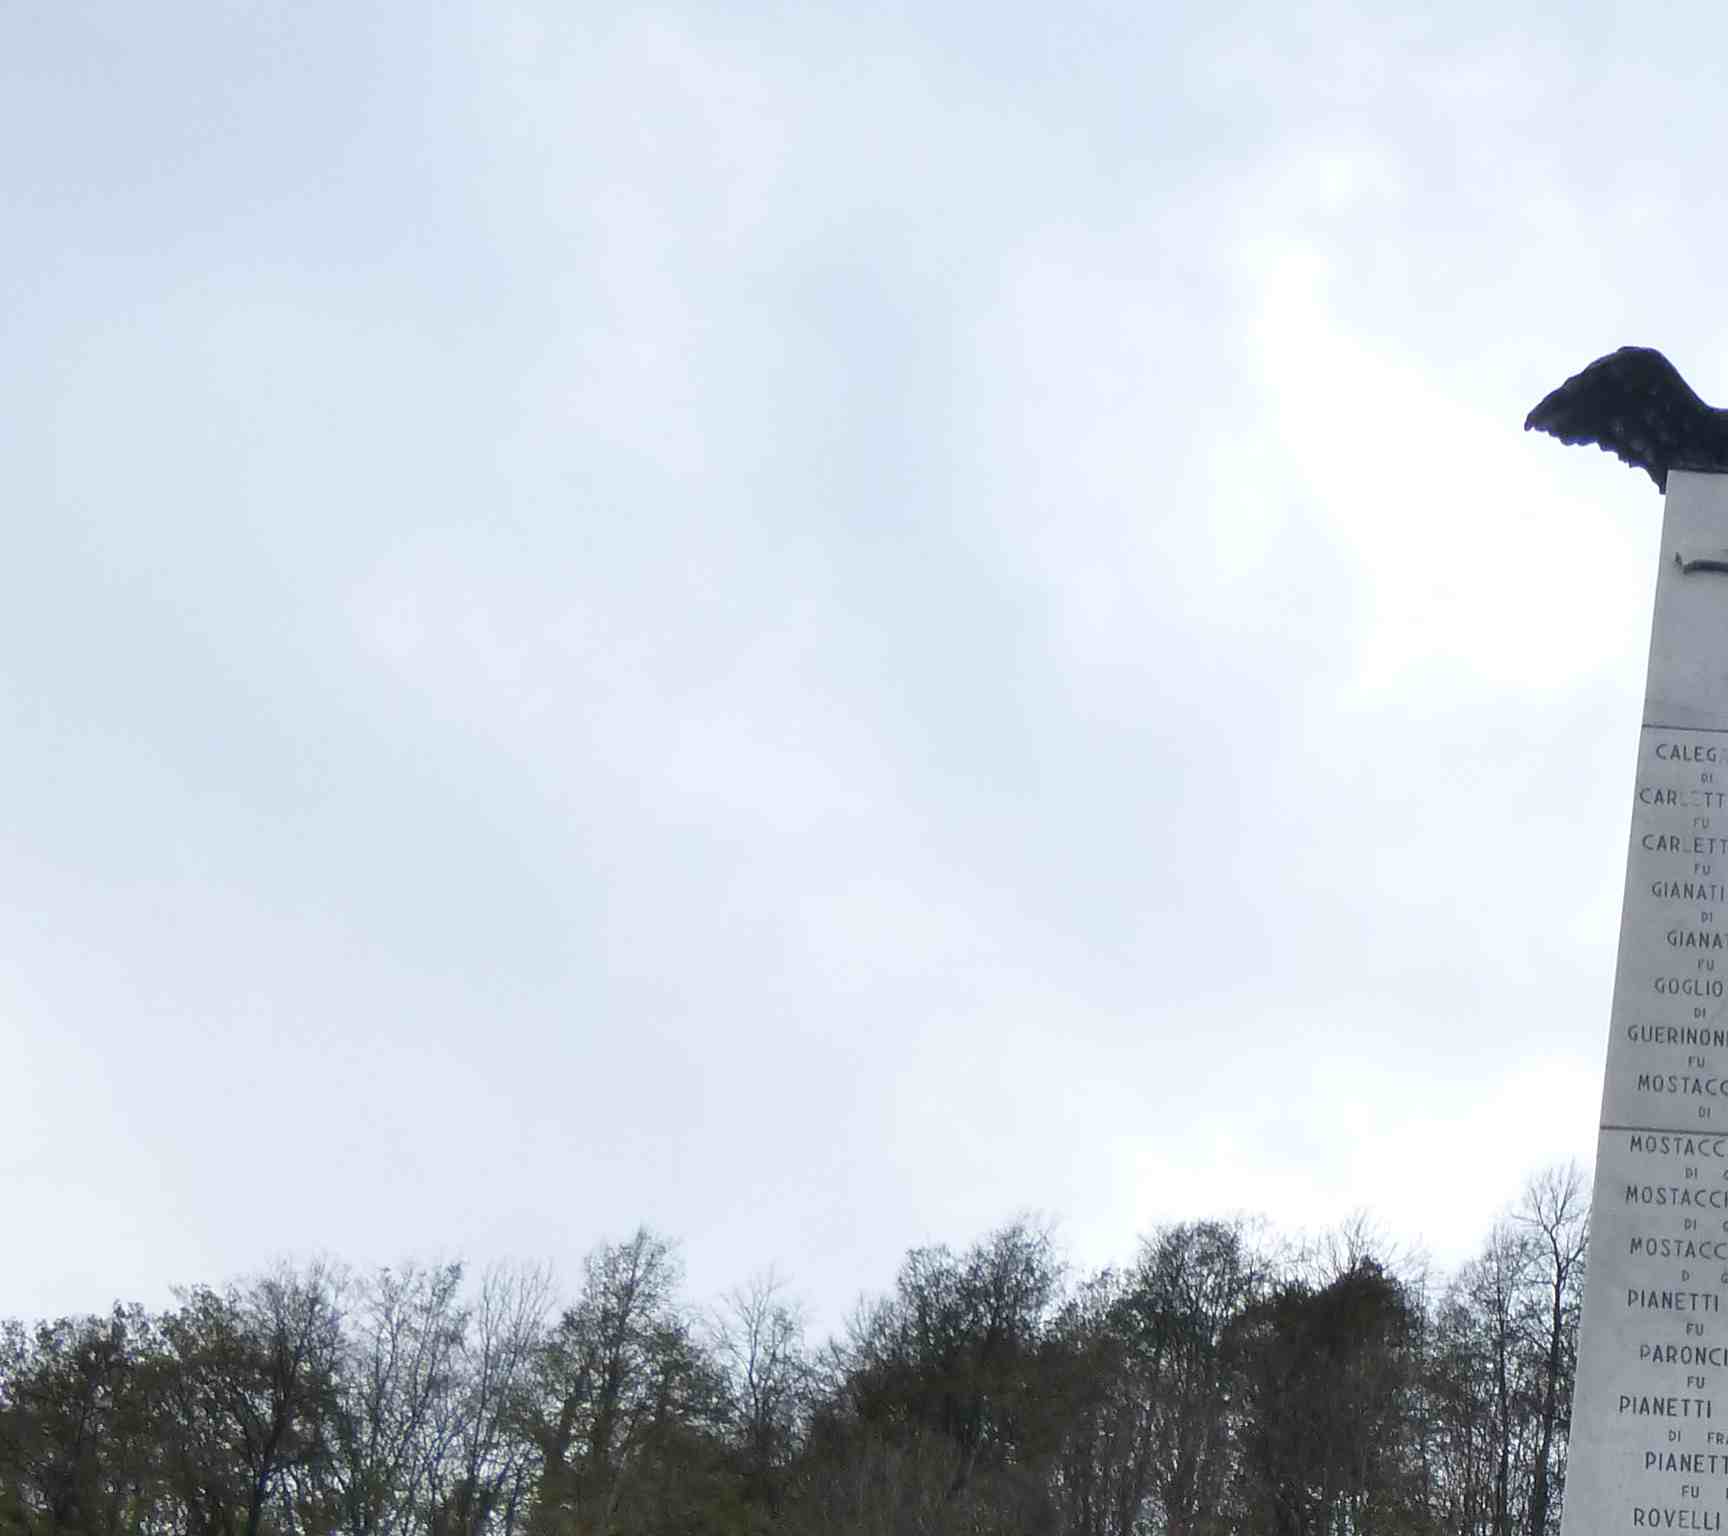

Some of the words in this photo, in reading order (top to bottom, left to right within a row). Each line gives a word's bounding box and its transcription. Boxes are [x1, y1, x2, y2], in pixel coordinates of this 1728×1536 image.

[1694, 818, 1710, 829] FU
[1694, 864, 1711, 876] FU
[1652, 881, 1725, 902] GIANATI
[1701, 912, 1712, 922] DI
[1698, 959, 1714, 971] FU
[1654, 977, 1723, 997] GOGLIO
[1694, 1007, 1706, 1018] DI
[1688, 1056, 1705, 1068] FU
[1699, 1107, 1711, 1119] DI
[1685, 1167, 1698, 1179] DI
[1684, 1219, 1697, 1232] DI
[1628, 1289, 1719, 1313] PIANETTI
[1686, 1323, 1704, 1336] FU
[1687, 1375, 1705, 1390] FU
[1619, 1395, 1712, 1419] PIANETTI
[1669, 1430, 1681, 1443] DI
[1682, 1485, 1700, 1498] FU
[1634, 1507, 1720, 1531] ROVELLI
